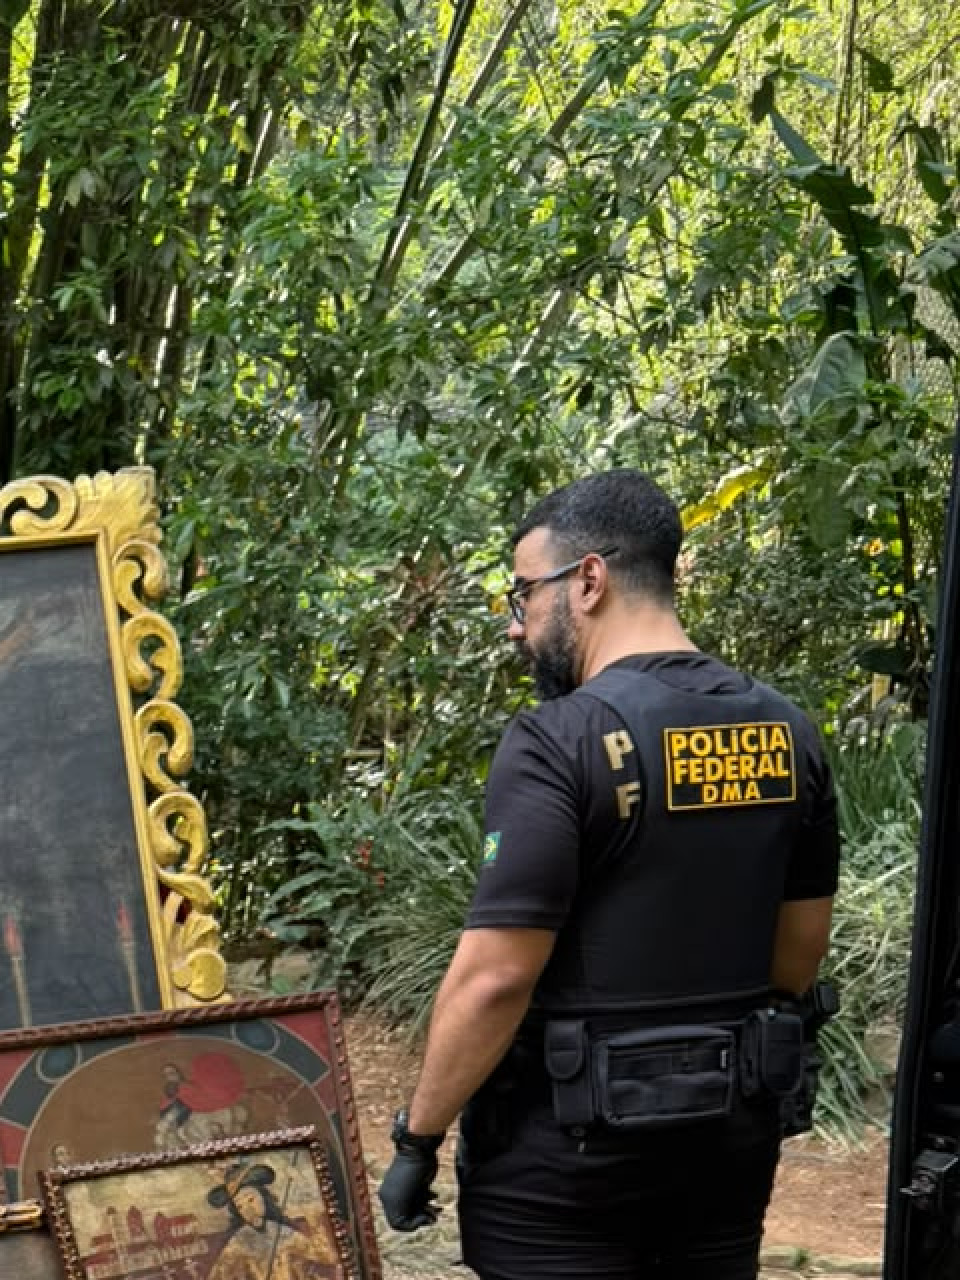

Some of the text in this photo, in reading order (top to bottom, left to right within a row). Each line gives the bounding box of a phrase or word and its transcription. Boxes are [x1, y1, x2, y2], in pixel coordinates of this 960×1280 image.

[671, 727, 788, 757] POLICIA
[673, 752, 790, 784] FEDERAL
[703, 782, 761, 803] DMA
